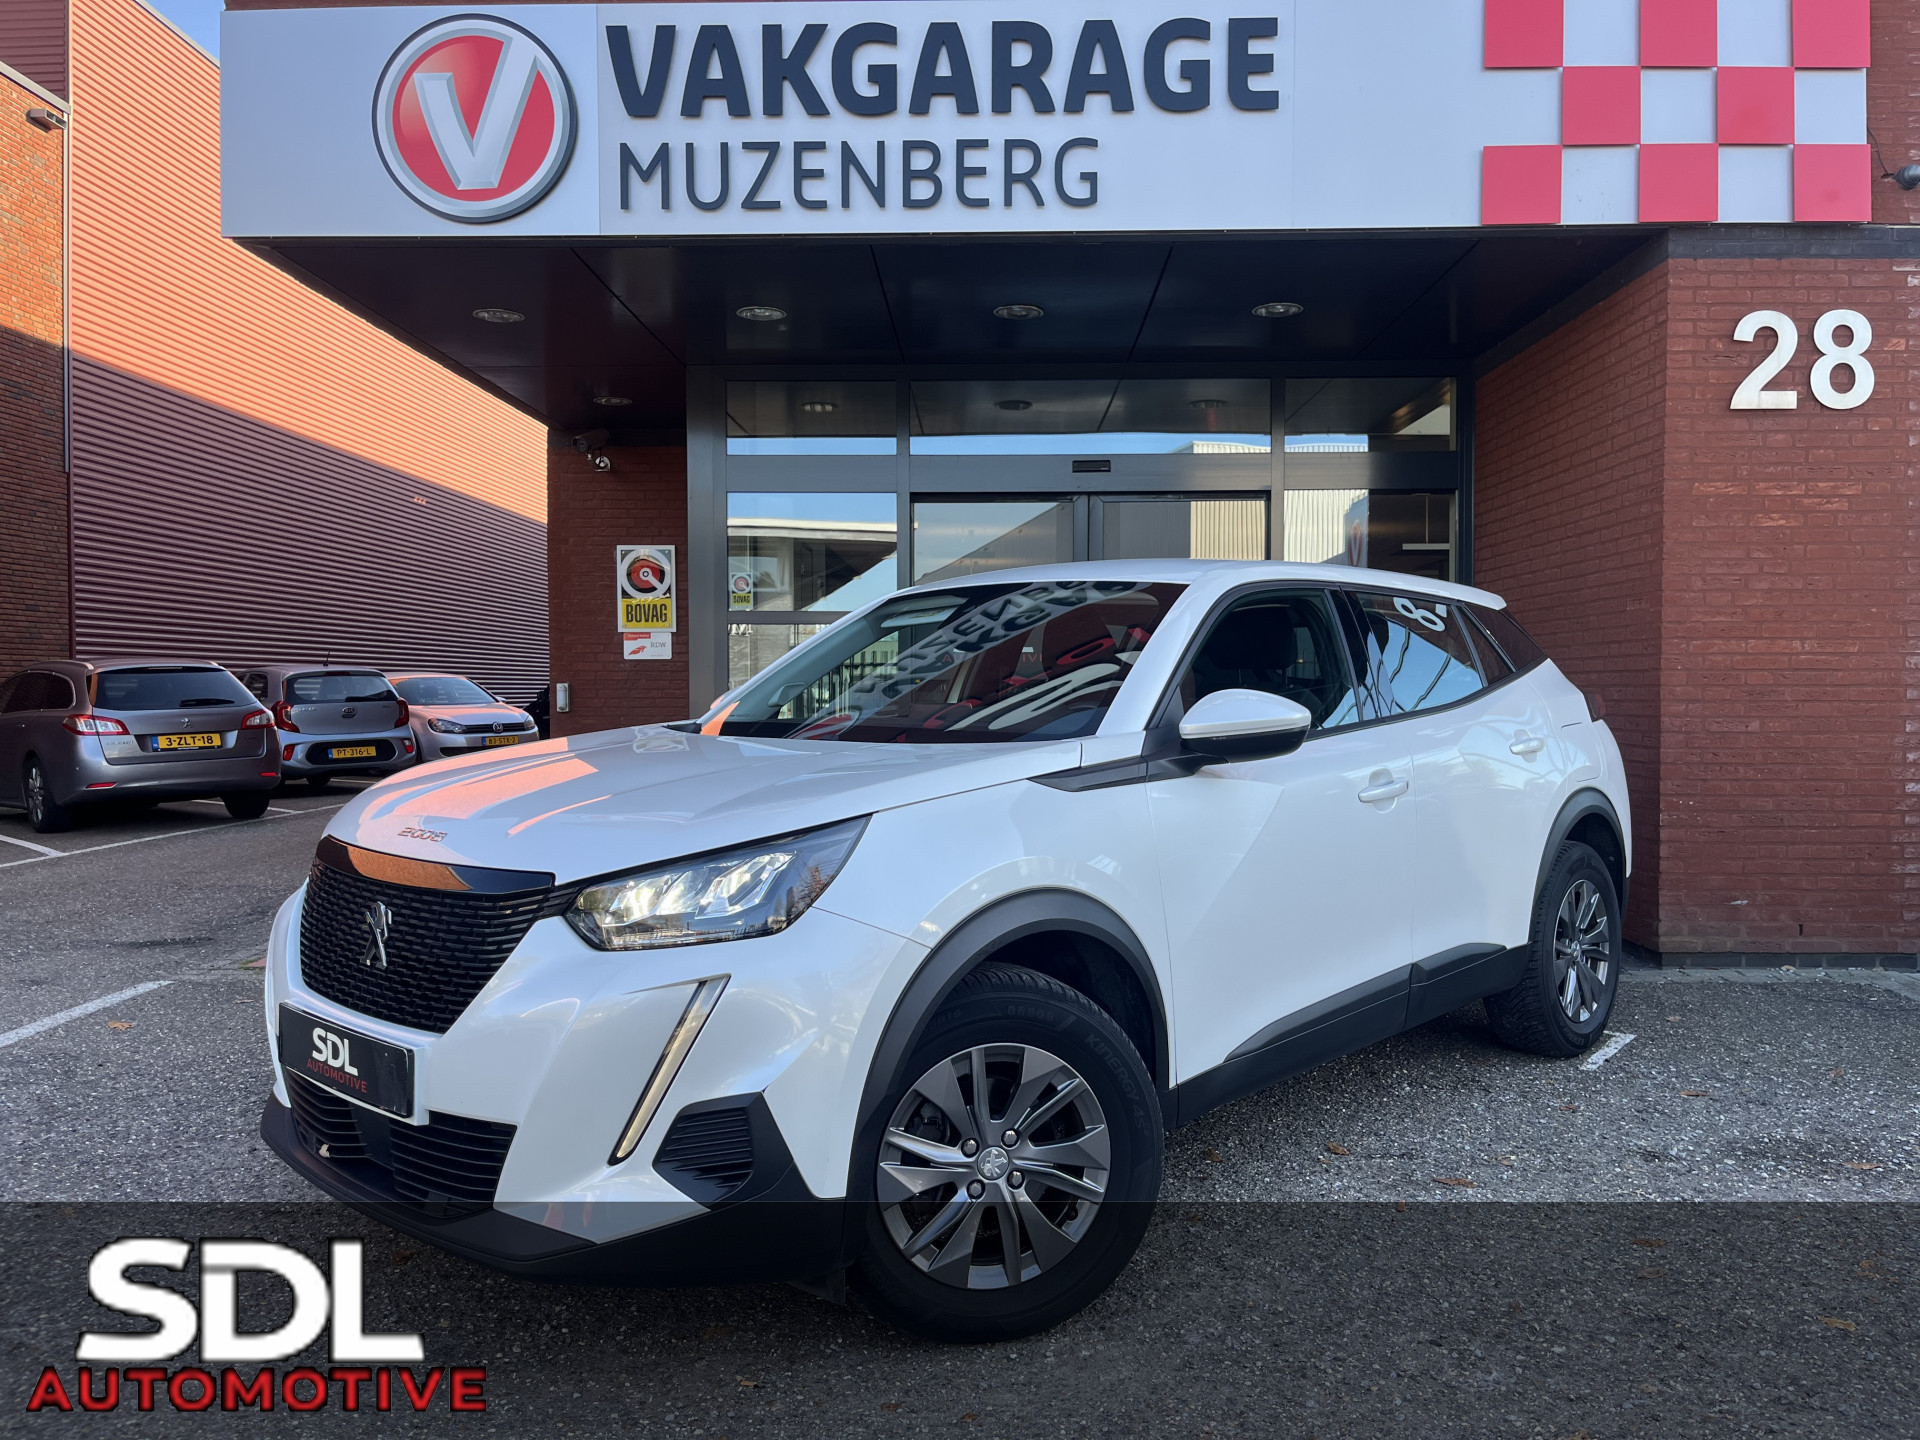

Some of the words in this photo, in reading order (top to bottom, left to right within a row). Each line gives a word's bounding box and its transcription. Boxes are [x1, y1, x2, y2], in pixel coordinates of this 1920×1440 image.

[606, 17, 1280, 117] VAKGARAGE
[620, 137, 1098, 210] MUZENBERG
[1730, 309, 1875, 410] 28
[625, 603, 668, 623] BOVAG
[165, 735, 214, 747] 3-ZLT-18
[336, 748, 372, 757] PT-316-L
[312, 1027, 359, 1077] SDL
[306, 1058, 368, 1094] AUTOMOTIVE
